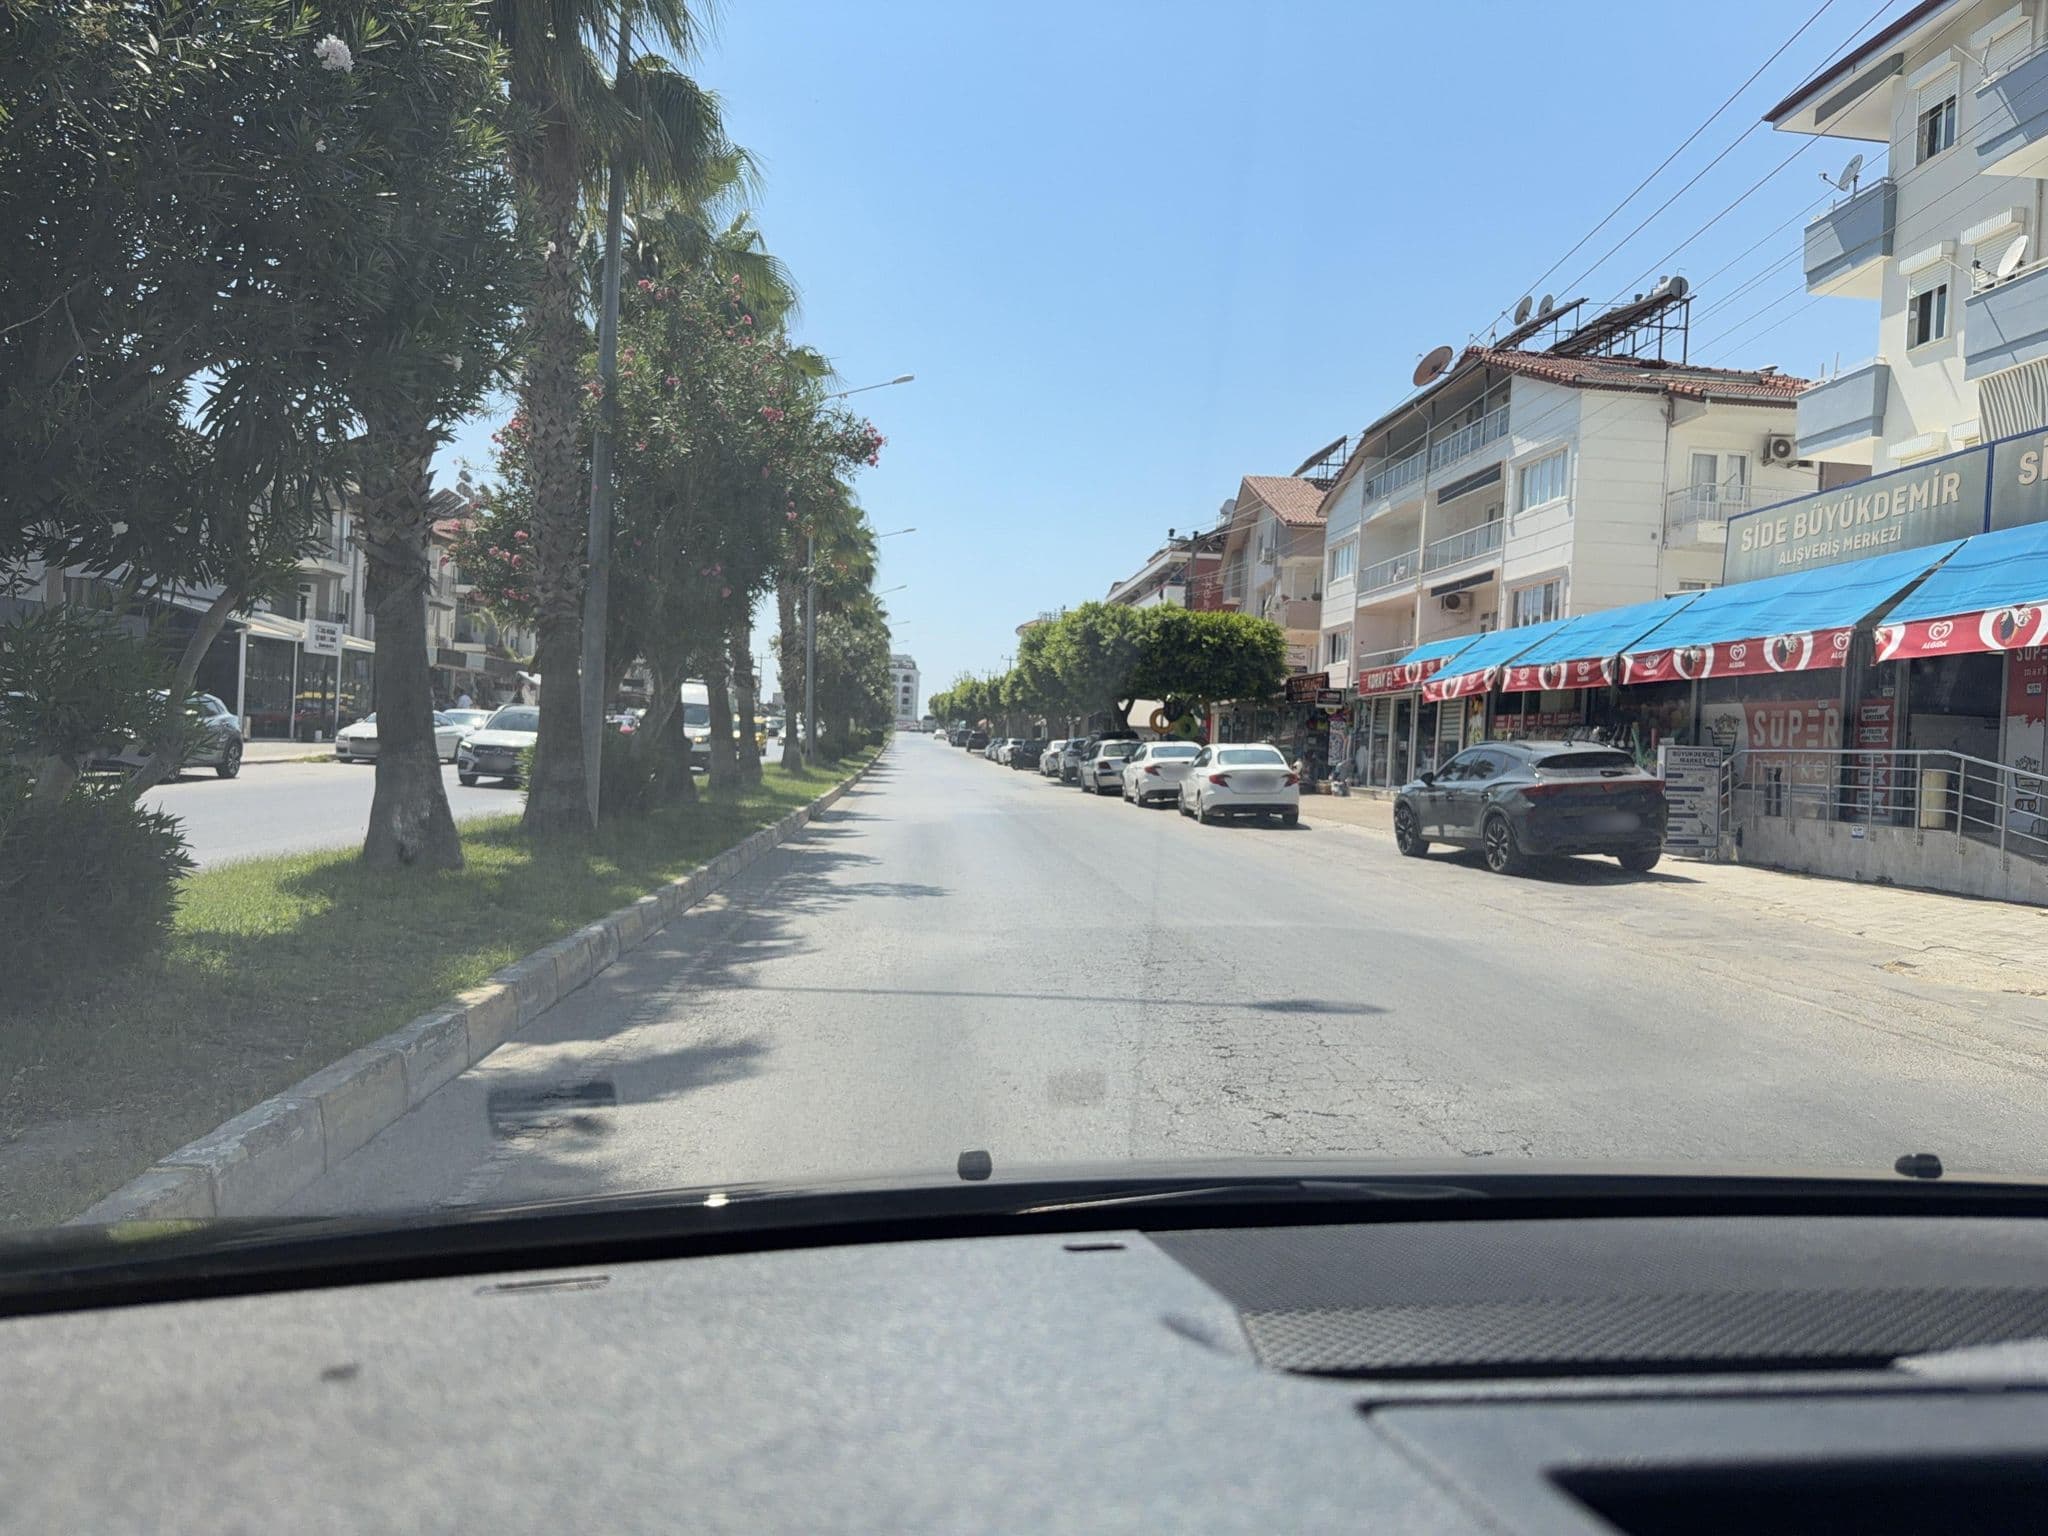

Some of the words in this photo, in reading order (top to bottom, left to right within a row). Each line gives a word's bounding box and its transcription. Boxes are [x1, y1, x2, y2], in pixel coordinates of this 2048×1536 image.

[1741, 518, 1788, 551] SİDE
[1793, 469, 1962, 539] BÜYÜKDEMİR
[1778, 537, 1840, 566] ALIŞVERİŞ
[1843, 522, 1902, 549] MERKEZİ
